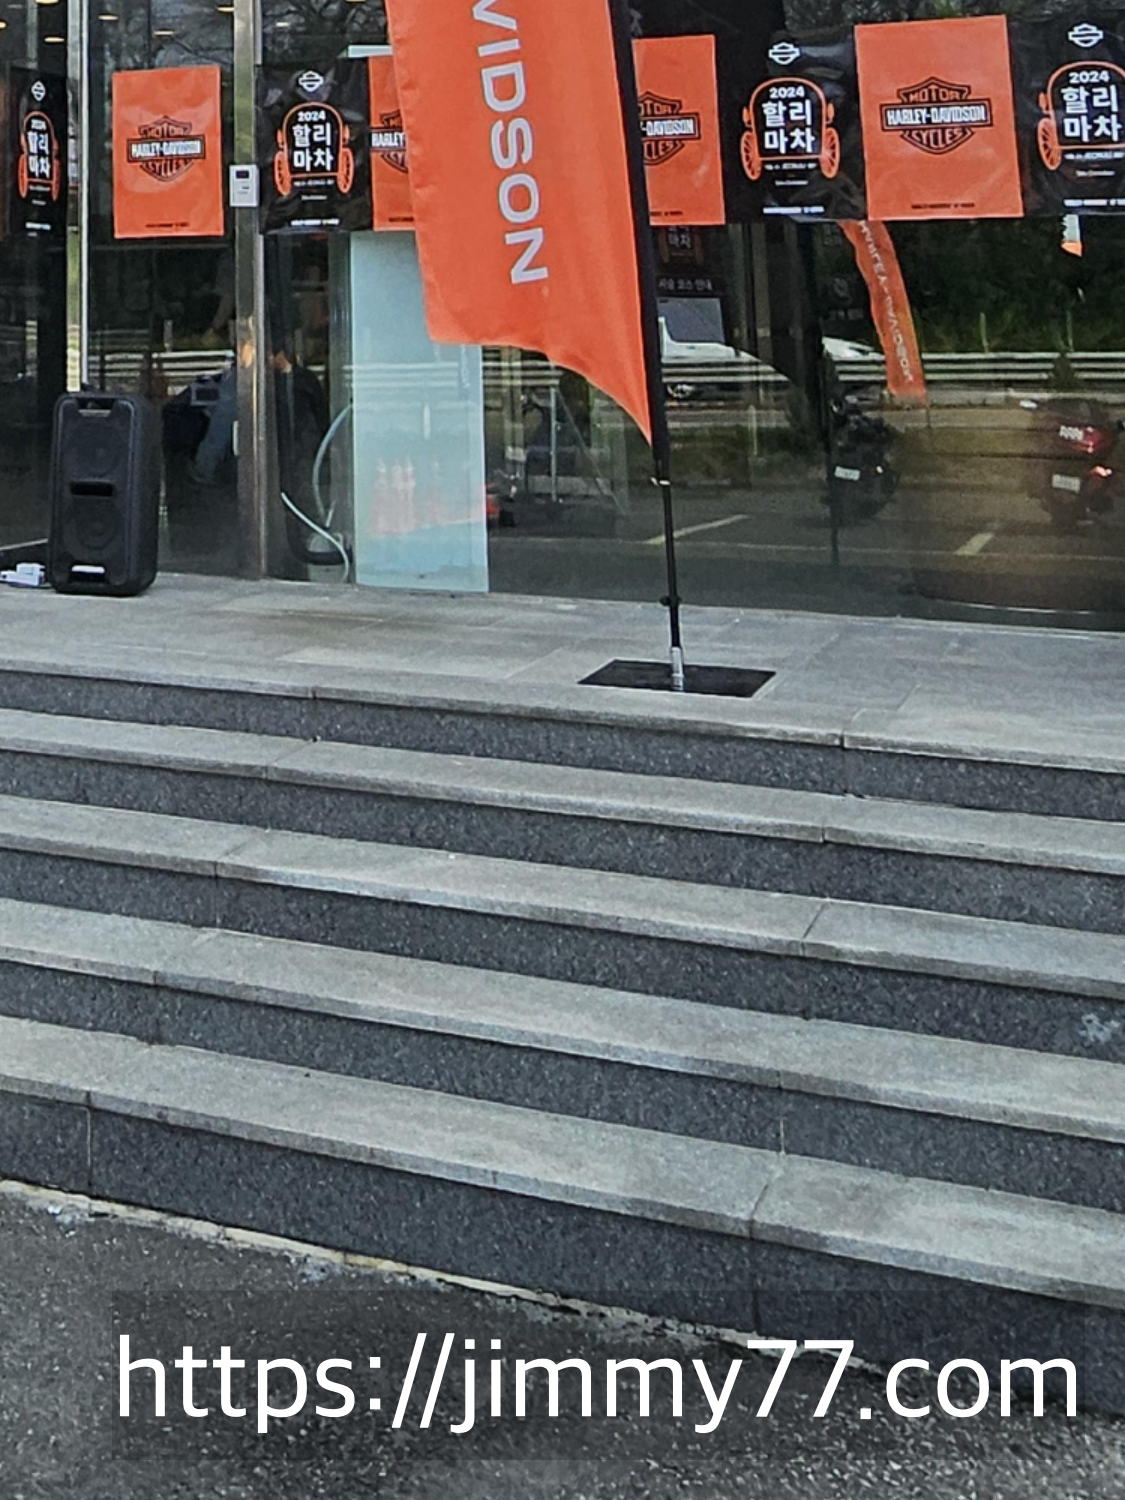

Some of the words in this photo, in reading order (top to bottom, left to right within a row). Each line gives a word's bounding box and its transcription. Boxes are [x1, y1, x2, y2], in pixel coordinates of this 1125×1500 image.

[1069, 71, 1111, 84] 2024
[769, 86, 805, 99] 2024
[1061, 85, 1118, 113] 할리
[297, 111, 326, 122] 2024
[761, 99, 813, 127] 할리
[886, 104, 987, 126] HARLEY-DAVIDSON
[292, 122, 331, 148] 할리
[1062, 114, 1122, 142] 마차
[371, 132, 405, 148] HARLEY
[764, 128, 815, 154] 마차
[293, 148, 333, 171] 마차
